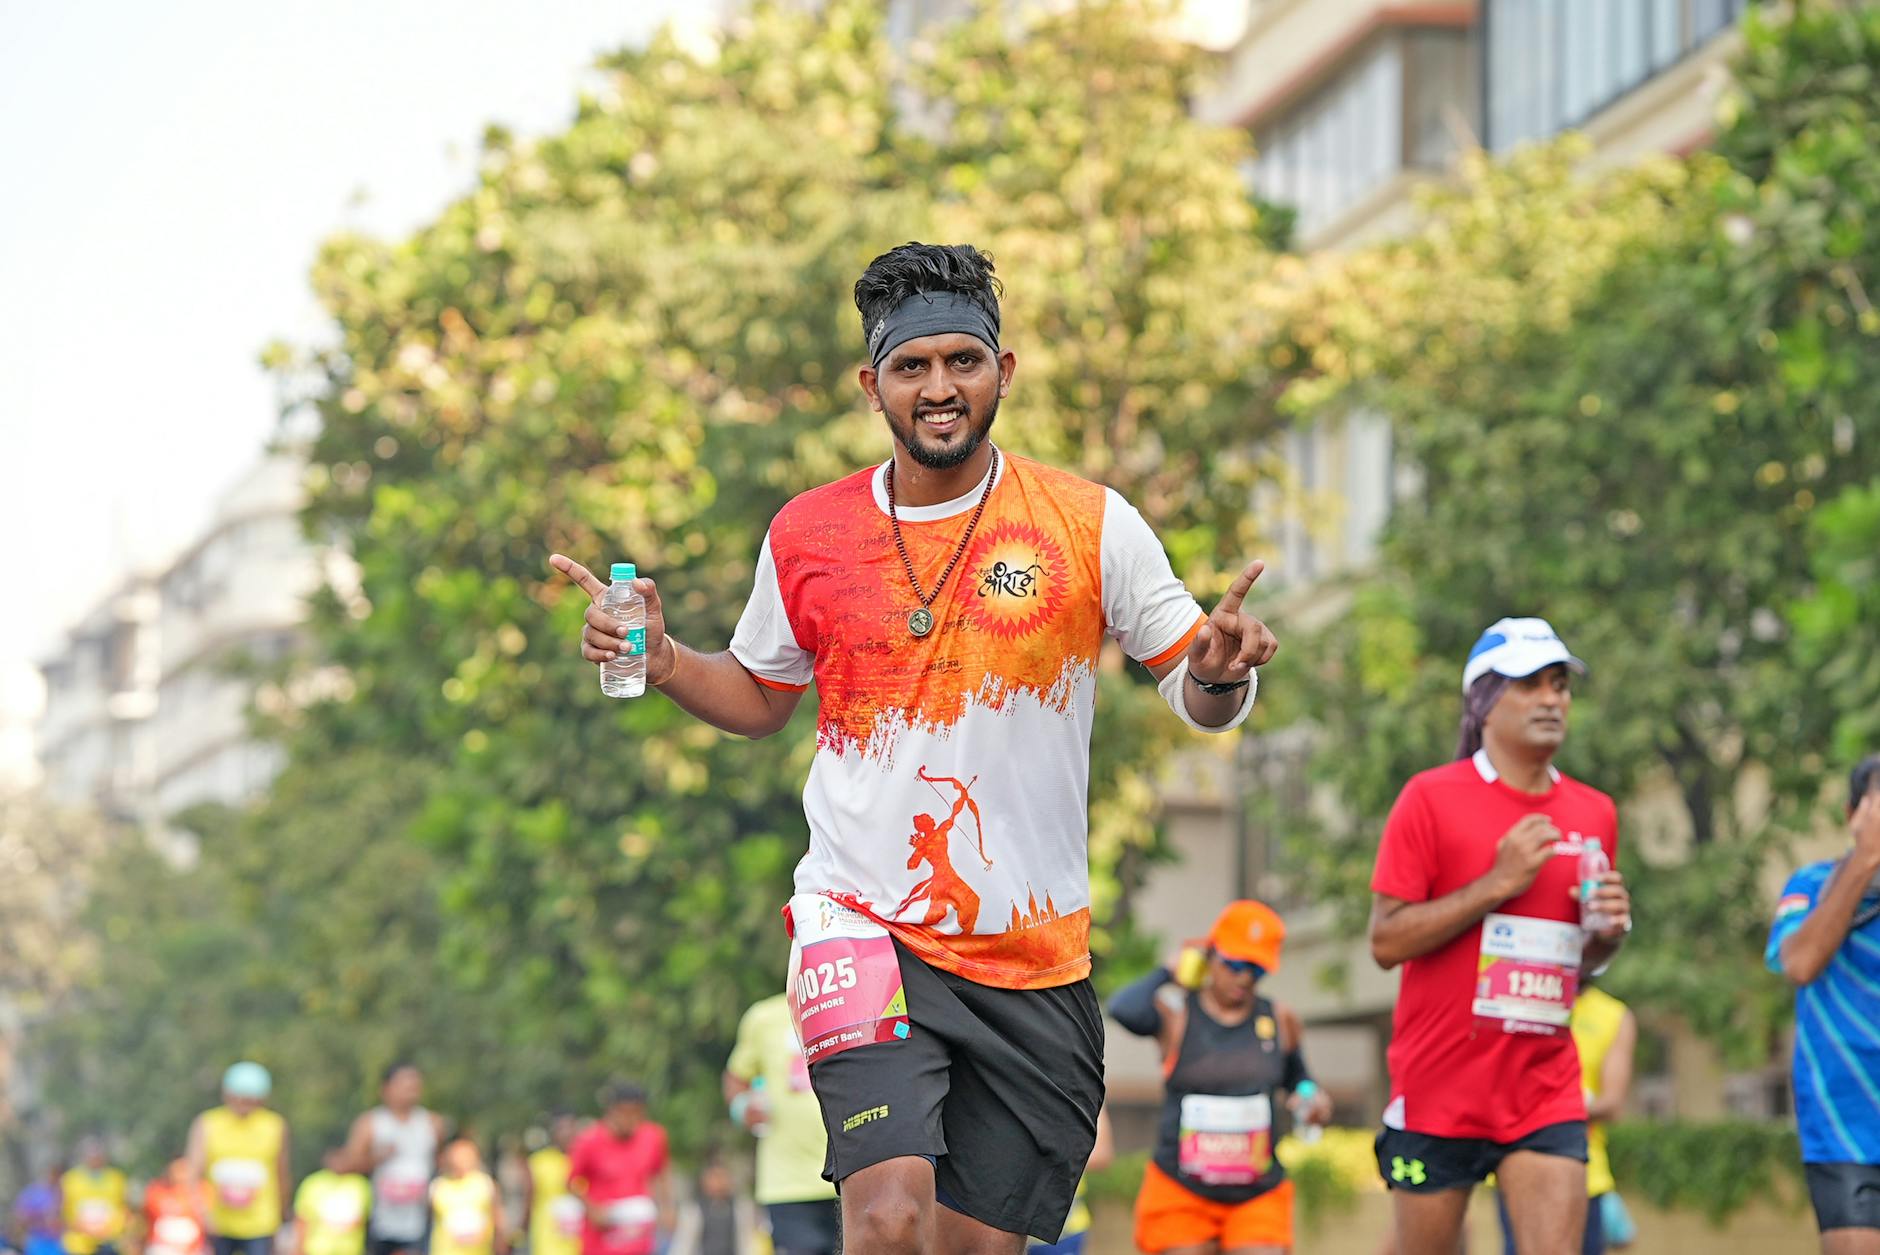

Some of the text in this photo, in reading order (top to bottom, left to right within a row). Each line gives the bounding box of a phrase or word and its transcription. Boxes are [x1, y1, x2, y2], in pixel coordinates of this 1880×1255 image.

[820, 996, 845, 1011] MORE
[819, 1035, 841, 1050] FIRST
[840, 1030, 864, 1042] Bank
[842, 1104, 889, 1132] MISFITS
